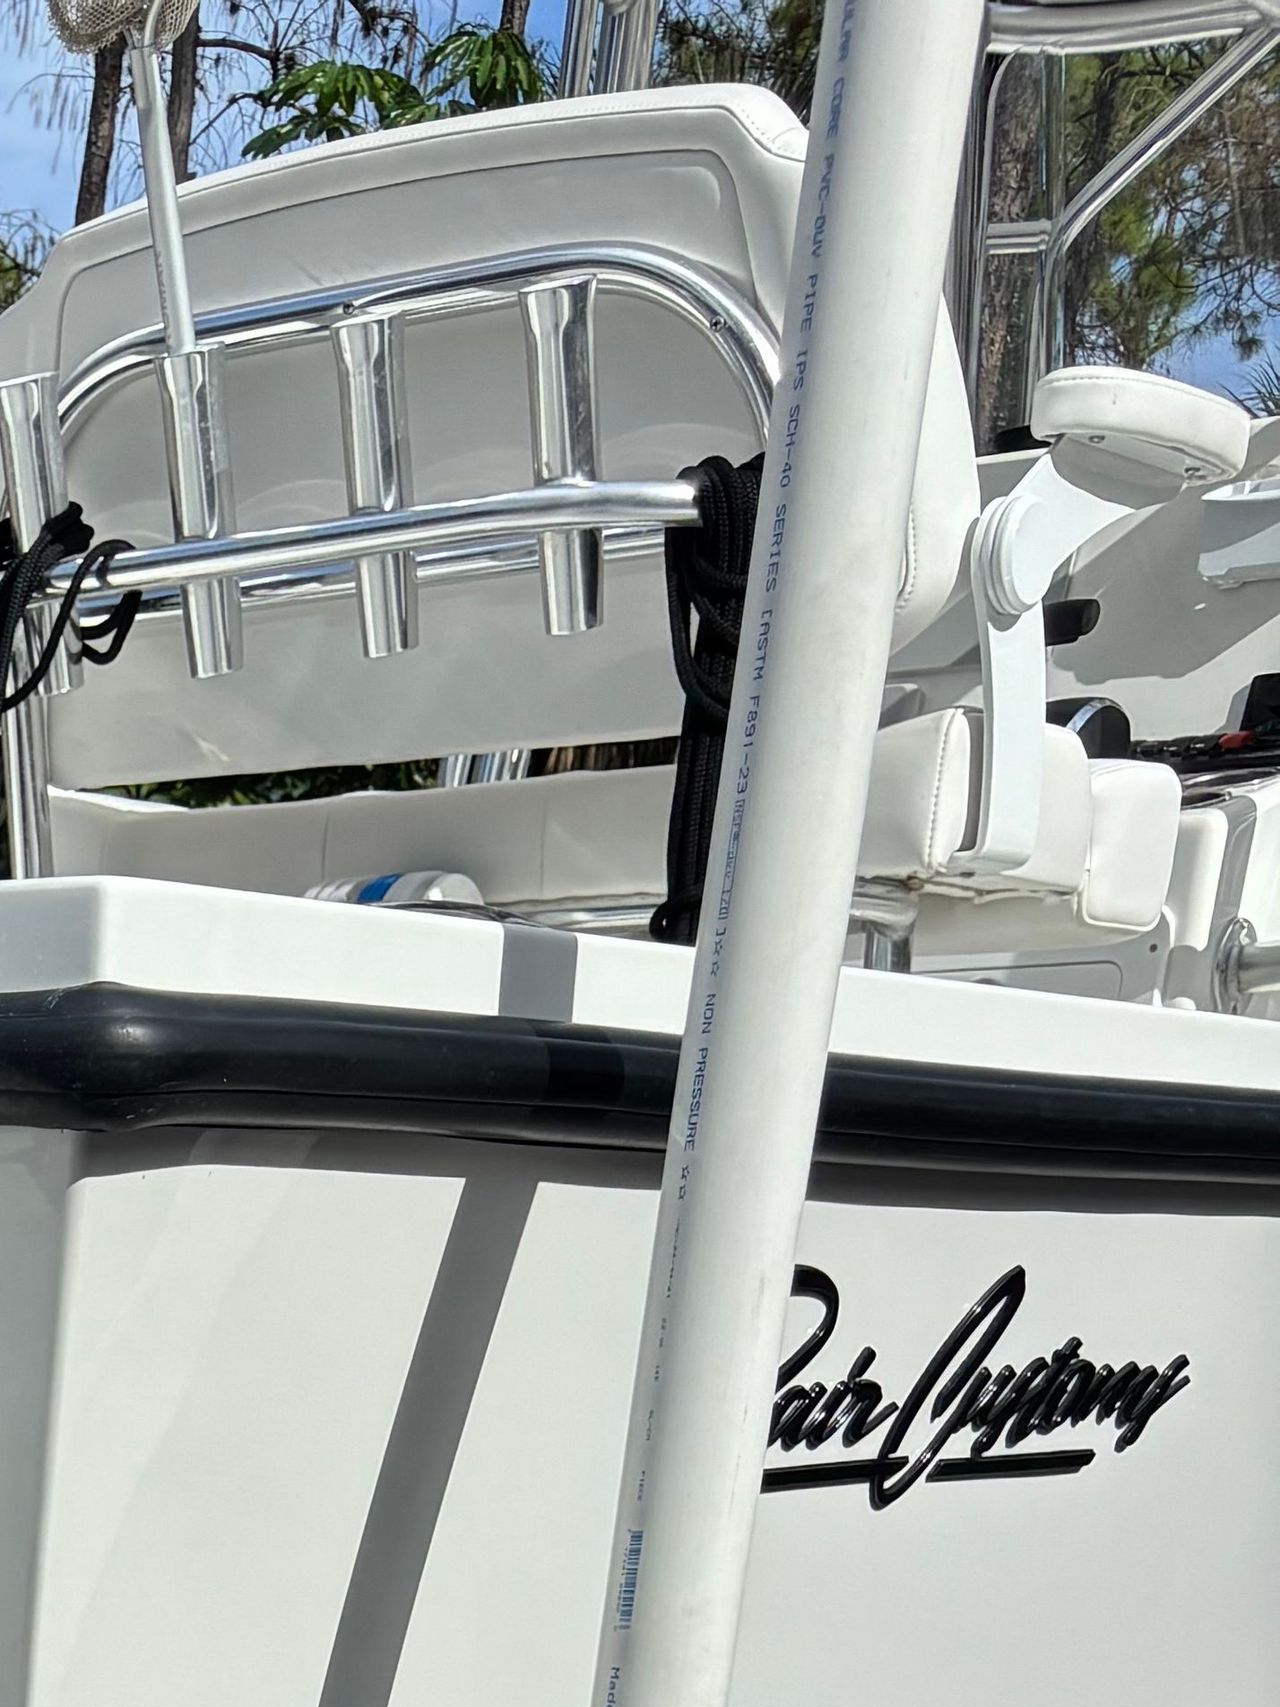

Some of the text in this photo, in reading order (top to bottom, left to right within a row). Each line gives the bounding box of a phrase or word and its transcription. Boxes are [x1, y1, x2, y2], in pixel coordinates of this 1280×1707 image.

[828, 77, 844, 137] CORE
[801, 274, 816, 333] PIPE
[793, 349, 807, 390] IPS
[780, 403, 799, 487] SCH-40
[765, 502, 786, 593] SERIES
[737, 694, 759, 793] F891-23
[685, 1046, 707, 1152] PRESSURE
